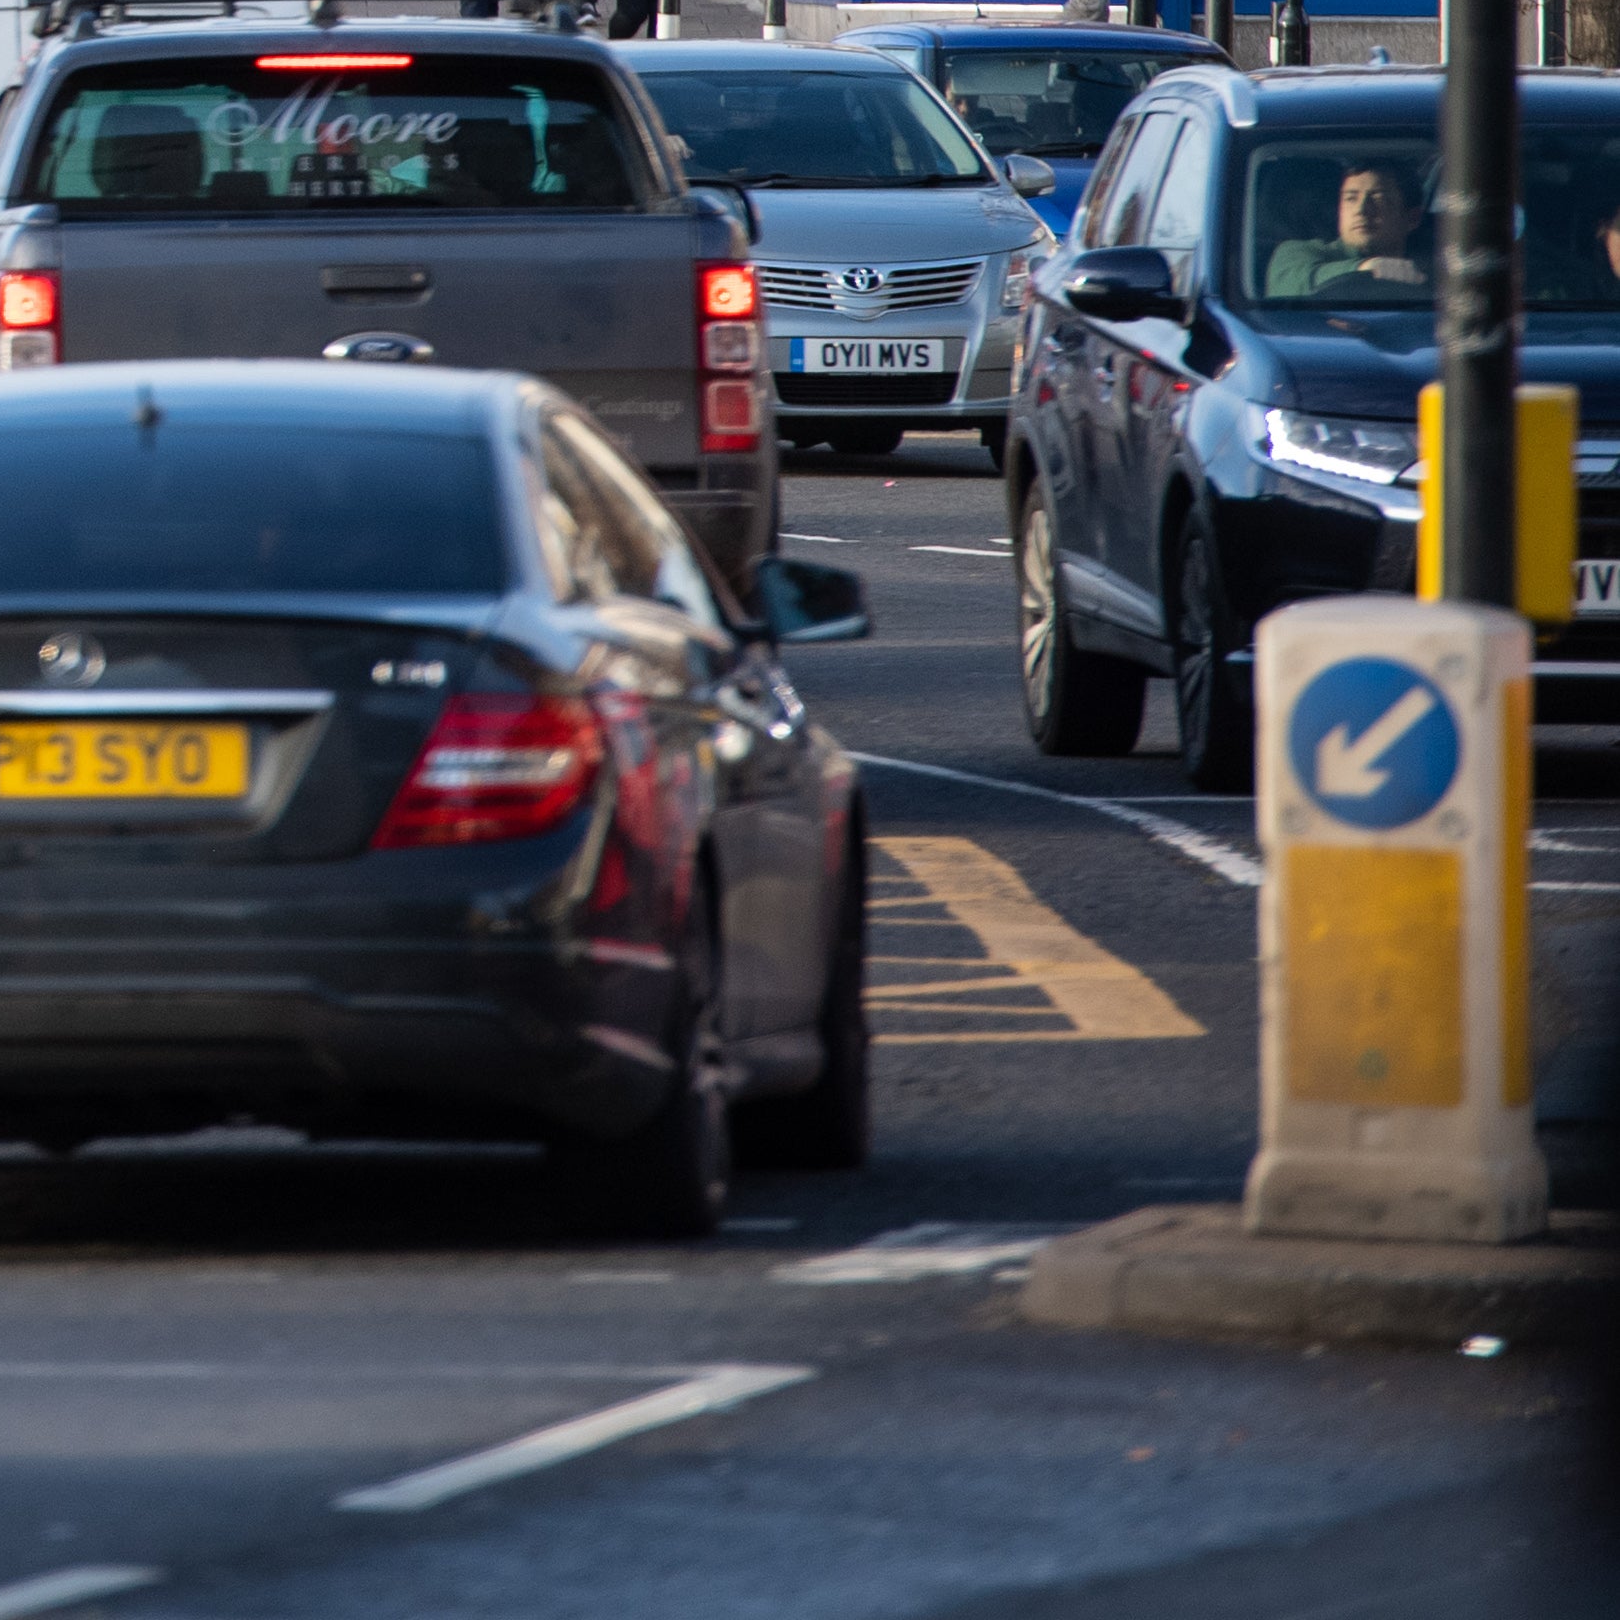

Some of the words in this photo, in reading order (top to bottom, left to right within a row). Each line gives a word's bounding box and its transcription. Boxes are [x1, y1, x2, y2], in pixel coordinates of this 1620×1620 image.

[208, 74, 462, 146] Moore
[822, 342, 871, 368] OY11
[879, 343, 930, 368] MVS
